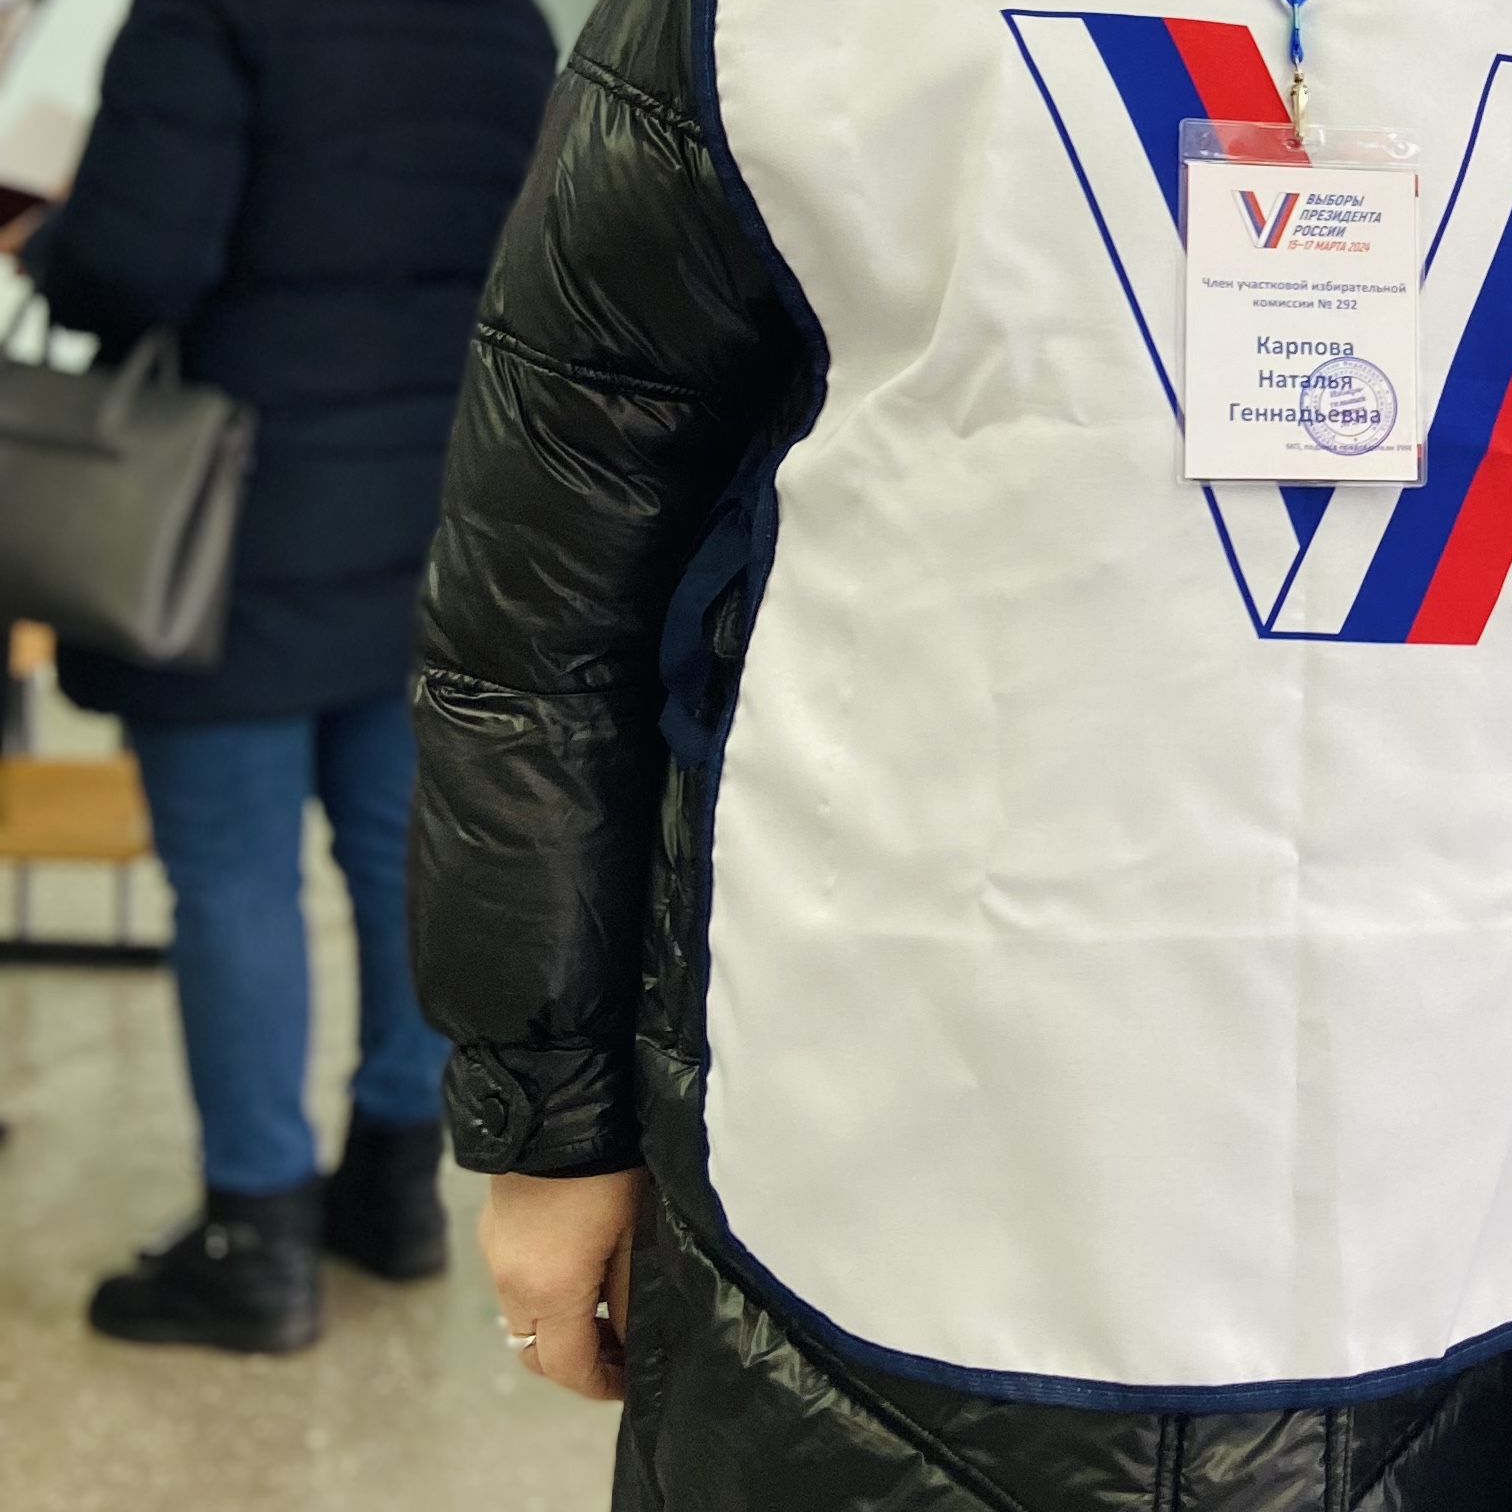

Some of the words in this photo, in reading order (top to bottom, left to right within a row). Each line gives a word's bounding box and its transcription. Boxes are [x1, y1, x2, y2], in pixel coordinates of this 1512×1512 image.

[1306, 193, 1365, 206] ВЫБОРЫ
[1300, 209, 1382, 223] ПРЕЗИДЕНТА
[1293, 225, 1347, 237] РОССИИ
[1314, 241, 1346, 251] МАРТА
[1347, 242, 1371, 252] 2024
[1201, 277, 1234, 289] Член
[1236, 280, 1308, 291] участковой
[1311, 281, 1406, 294] избирательной
[1253, 299, 1314, 309] комиссии
[1317, 299, 1332, 309] №
[1336, 300, 1358, 310] 292
[1256, 336, 1354, 359] Карпова
[1258, 370, 1353, 389] Наталья
[1229, 403, 1381, 426] Геннадьевна
